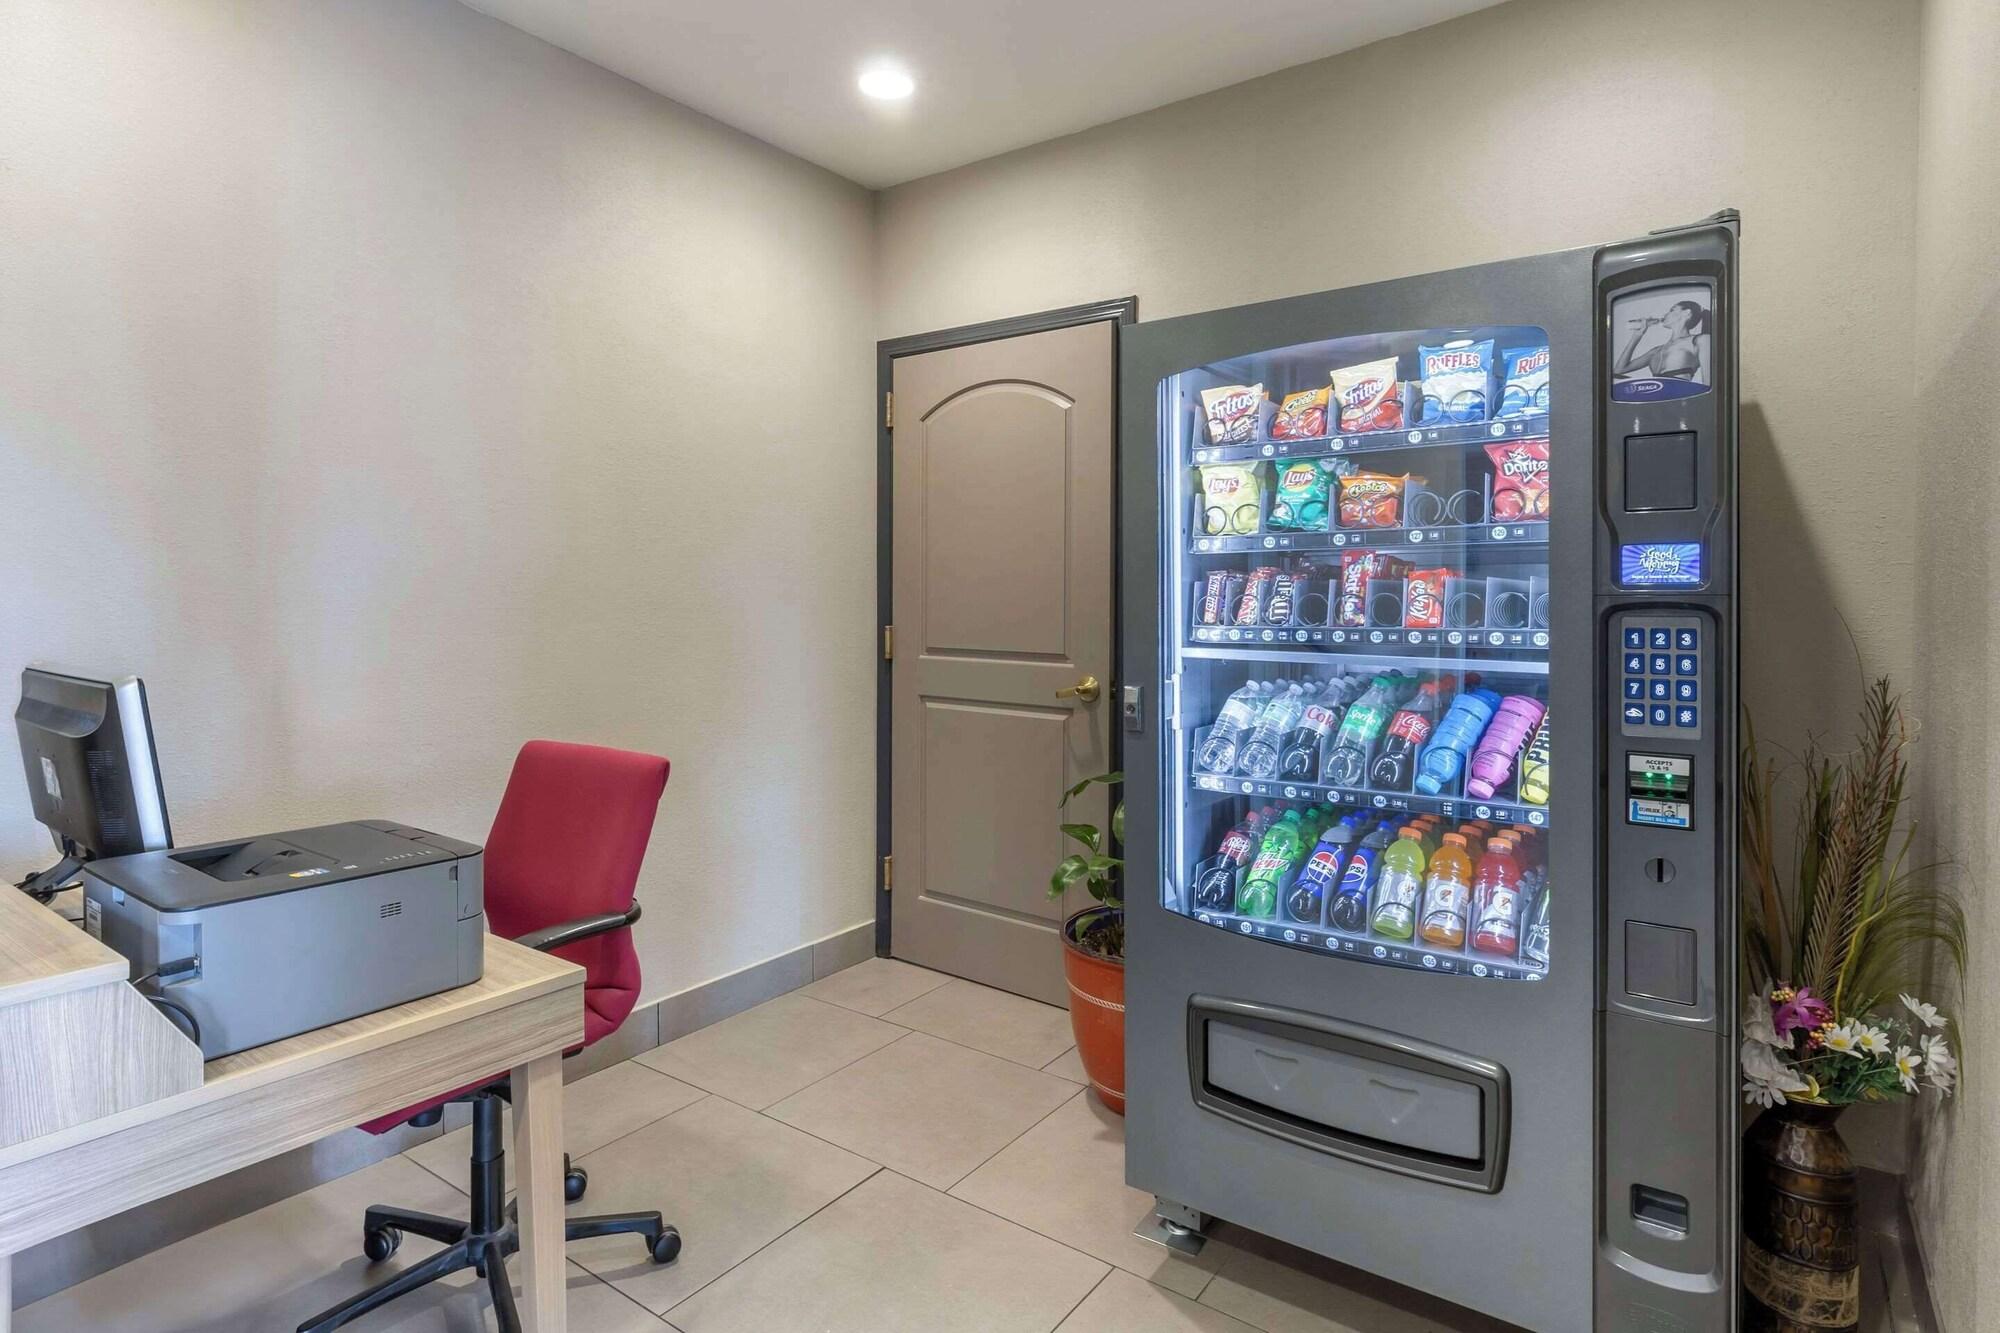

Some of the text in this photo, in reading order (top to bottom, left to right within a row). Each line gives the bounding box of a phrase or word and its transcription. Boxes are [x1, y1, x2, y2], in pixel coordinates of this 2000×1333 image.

[1427, 352, 1480, 373] RUFFLES
[1517, 352, 1549, 374] RUFF
[1343, 378, 1384, 405] Fritos
[1209, 394, 1254, 419] Fritos
[1503, 458, 1548, 476] Dorito
[1647, 547, 1673, 560] Good
[1631, 632, 1639, 645] 1
[1655, 633, 1665, 645] 2
[1681, 633, 1691, 646] 3
[1630, 658, 1639, 669] 4
[1656, 658, 1665, 670] 5
[1682, 659, 1692, 671] 6
[1630, 682, 1639, 694] 7
[1656, 684, 1664, 696] 8
[1682, 684, 1692, 696] 9
[1307, 706, 1337, 729] Coke
[1656, 710, 1665, 721] 0
[1350, 864, 1366, 876] PSI
